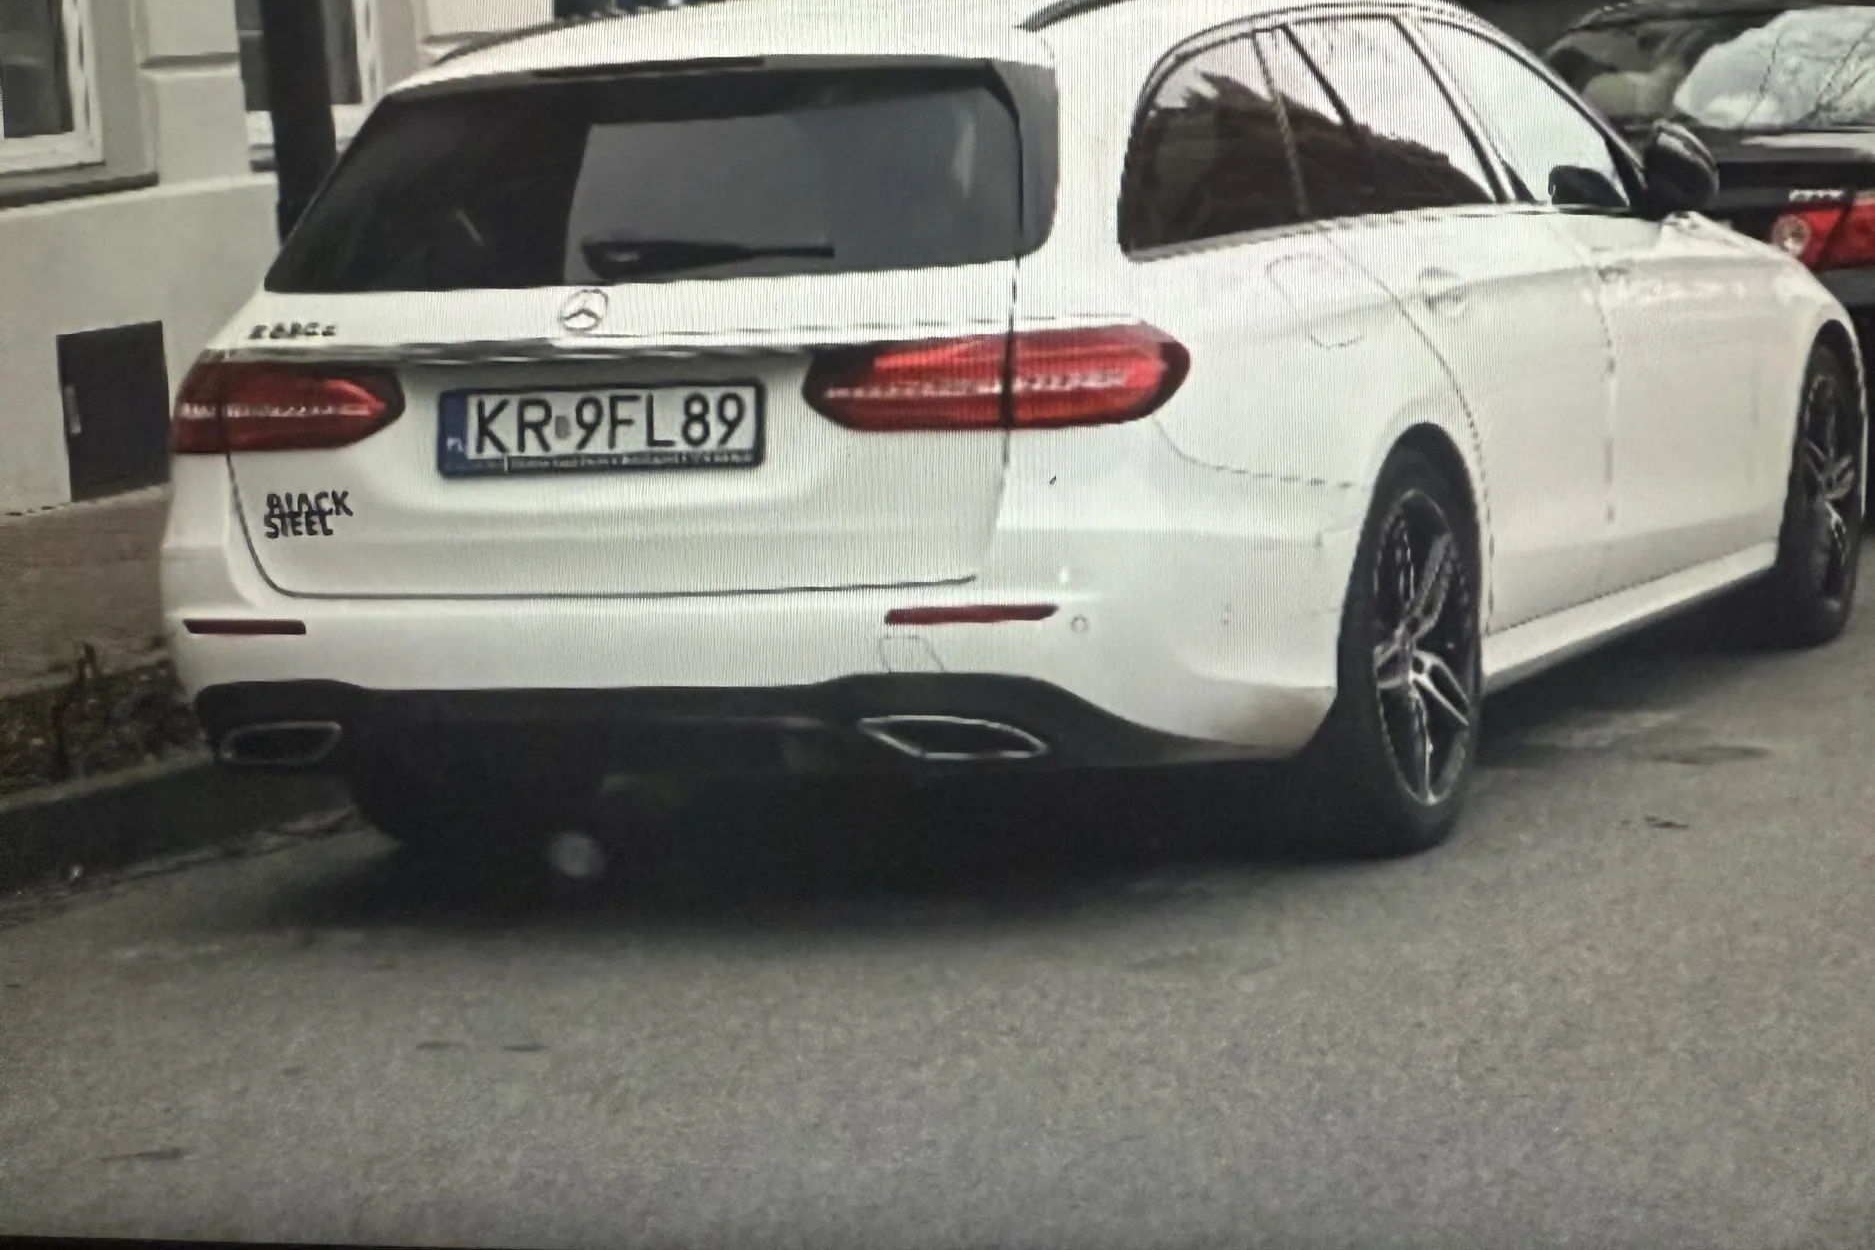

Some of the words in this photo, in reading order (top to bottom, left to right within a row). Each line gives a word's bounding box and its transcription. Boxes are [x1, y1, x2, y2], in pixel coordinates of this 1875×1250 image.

[475, 397, 551, 453] KR
[574, 391, 746, 451] 9FL89
[264, 512, 334, 539] STEEL
